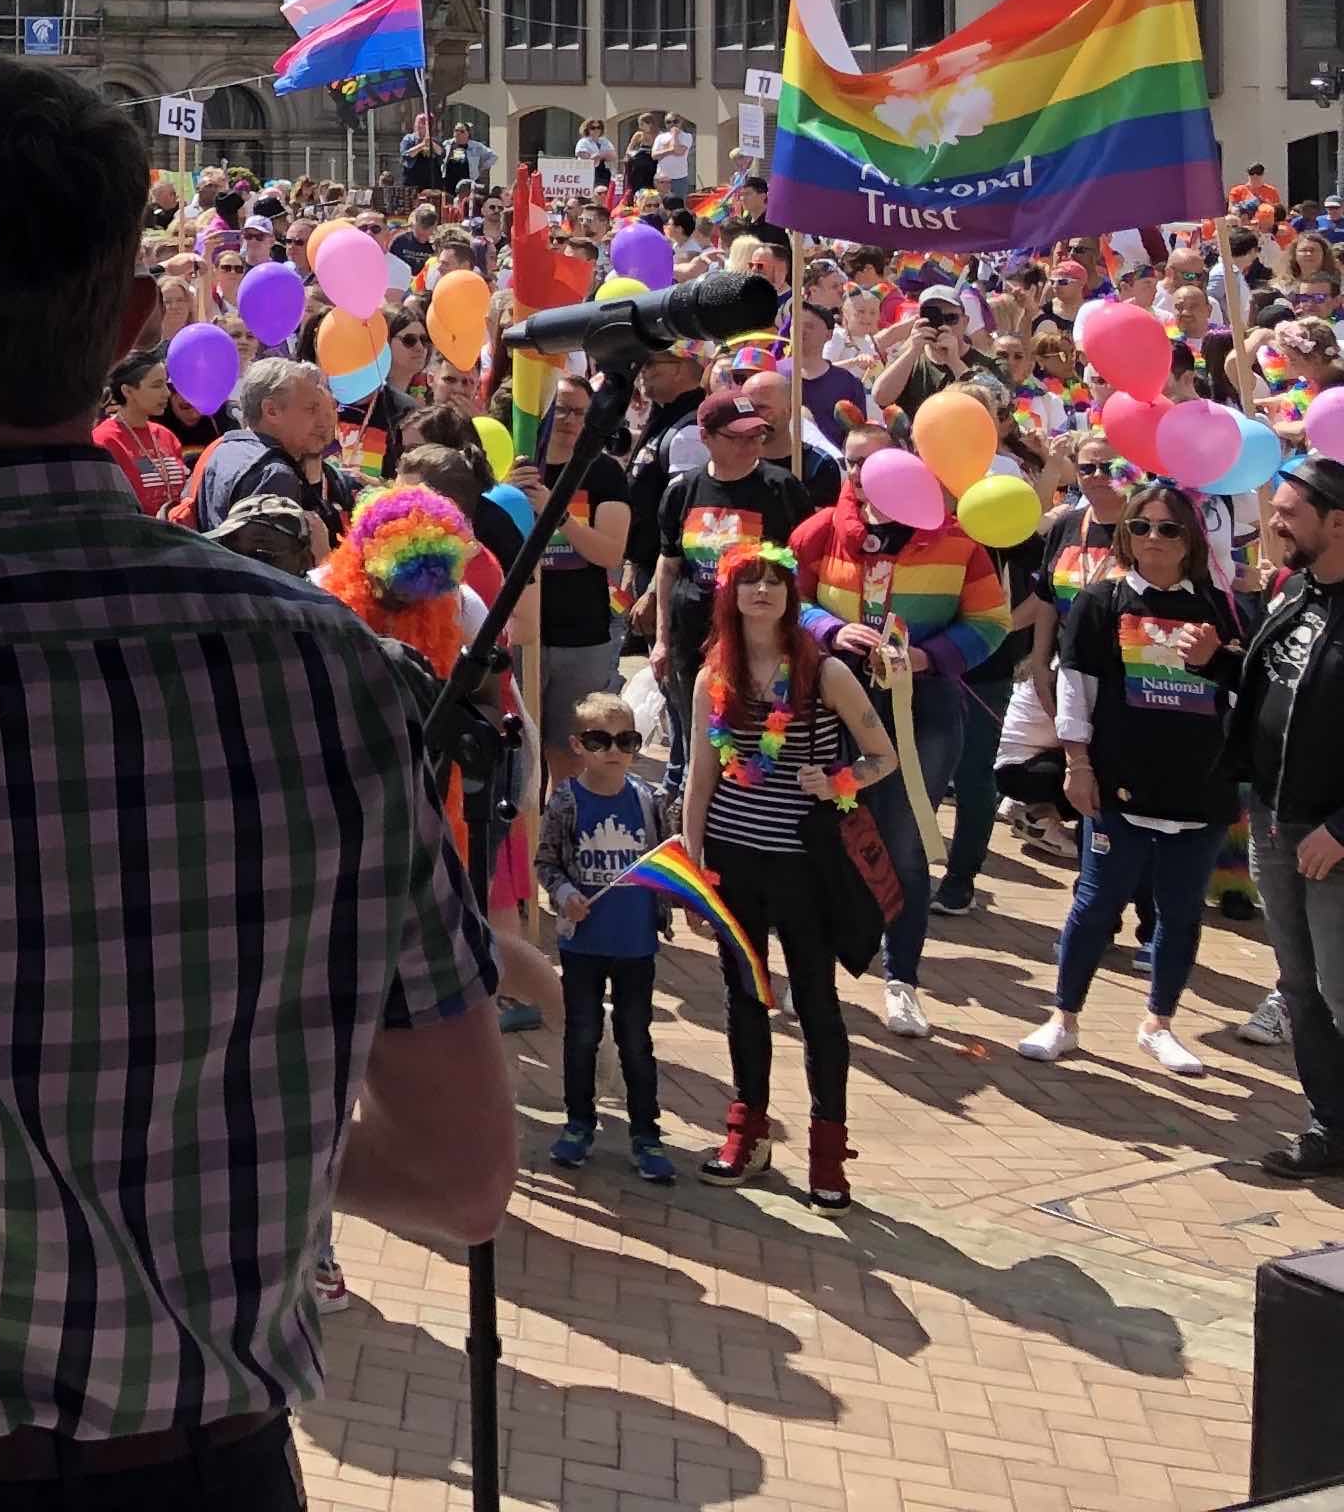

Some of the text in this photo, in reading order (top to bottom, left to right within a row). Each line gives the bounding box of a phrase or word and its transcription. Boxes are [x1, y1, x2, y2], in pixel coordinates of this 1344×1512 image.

[168, 106, 195, 133] 45
[553, 174, 580, 183] FACE
[543, 188, 591, 197] AINTING
[859, 187, 961, 231] Trust
[1141, 676, 1204, 695] National
[1142, 690, 1181, 706] Trust
